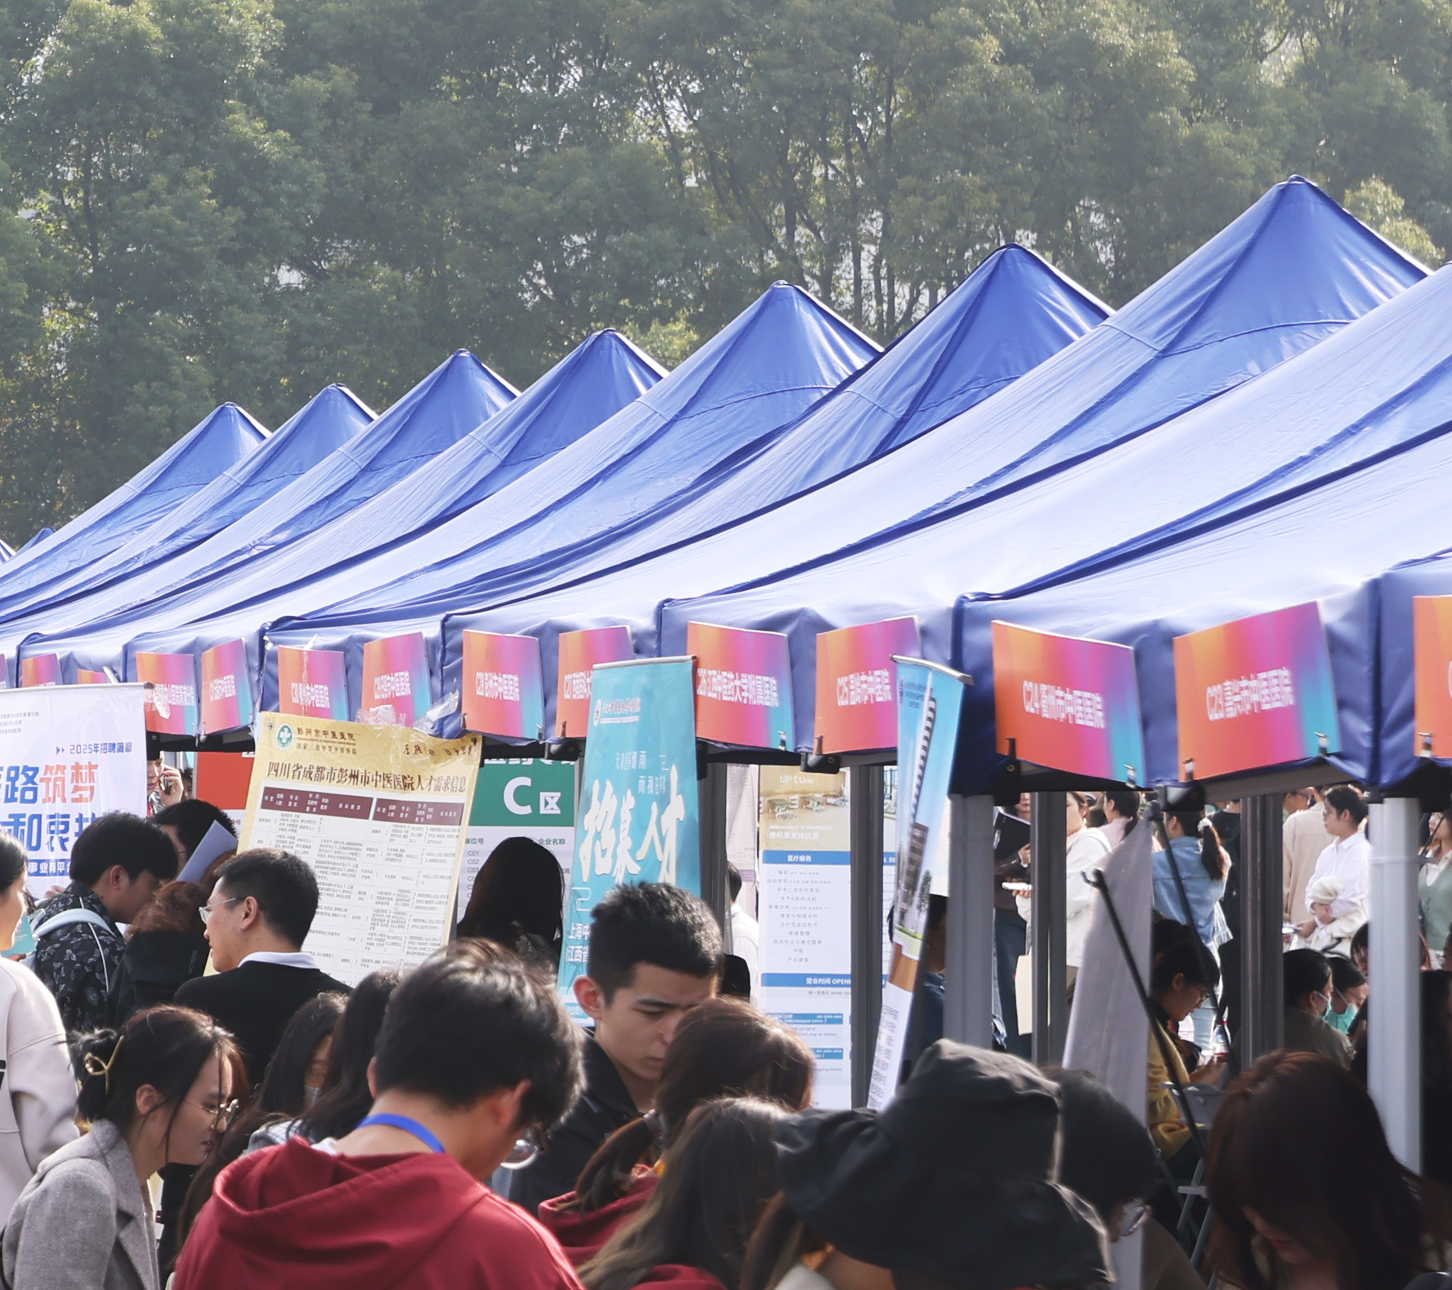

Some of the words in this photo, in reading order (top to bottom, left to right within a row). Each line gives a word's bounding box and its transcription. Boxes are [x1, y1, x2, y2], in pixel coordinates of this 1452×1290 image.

[69, 742, 133, 755] 2025年招聘简章
[266, 761, 467, 794] 四川省成都市彭州市中医医院人才需求信息
[503, 776, 532, 815] C
[539, 791, 562, 815] 区
